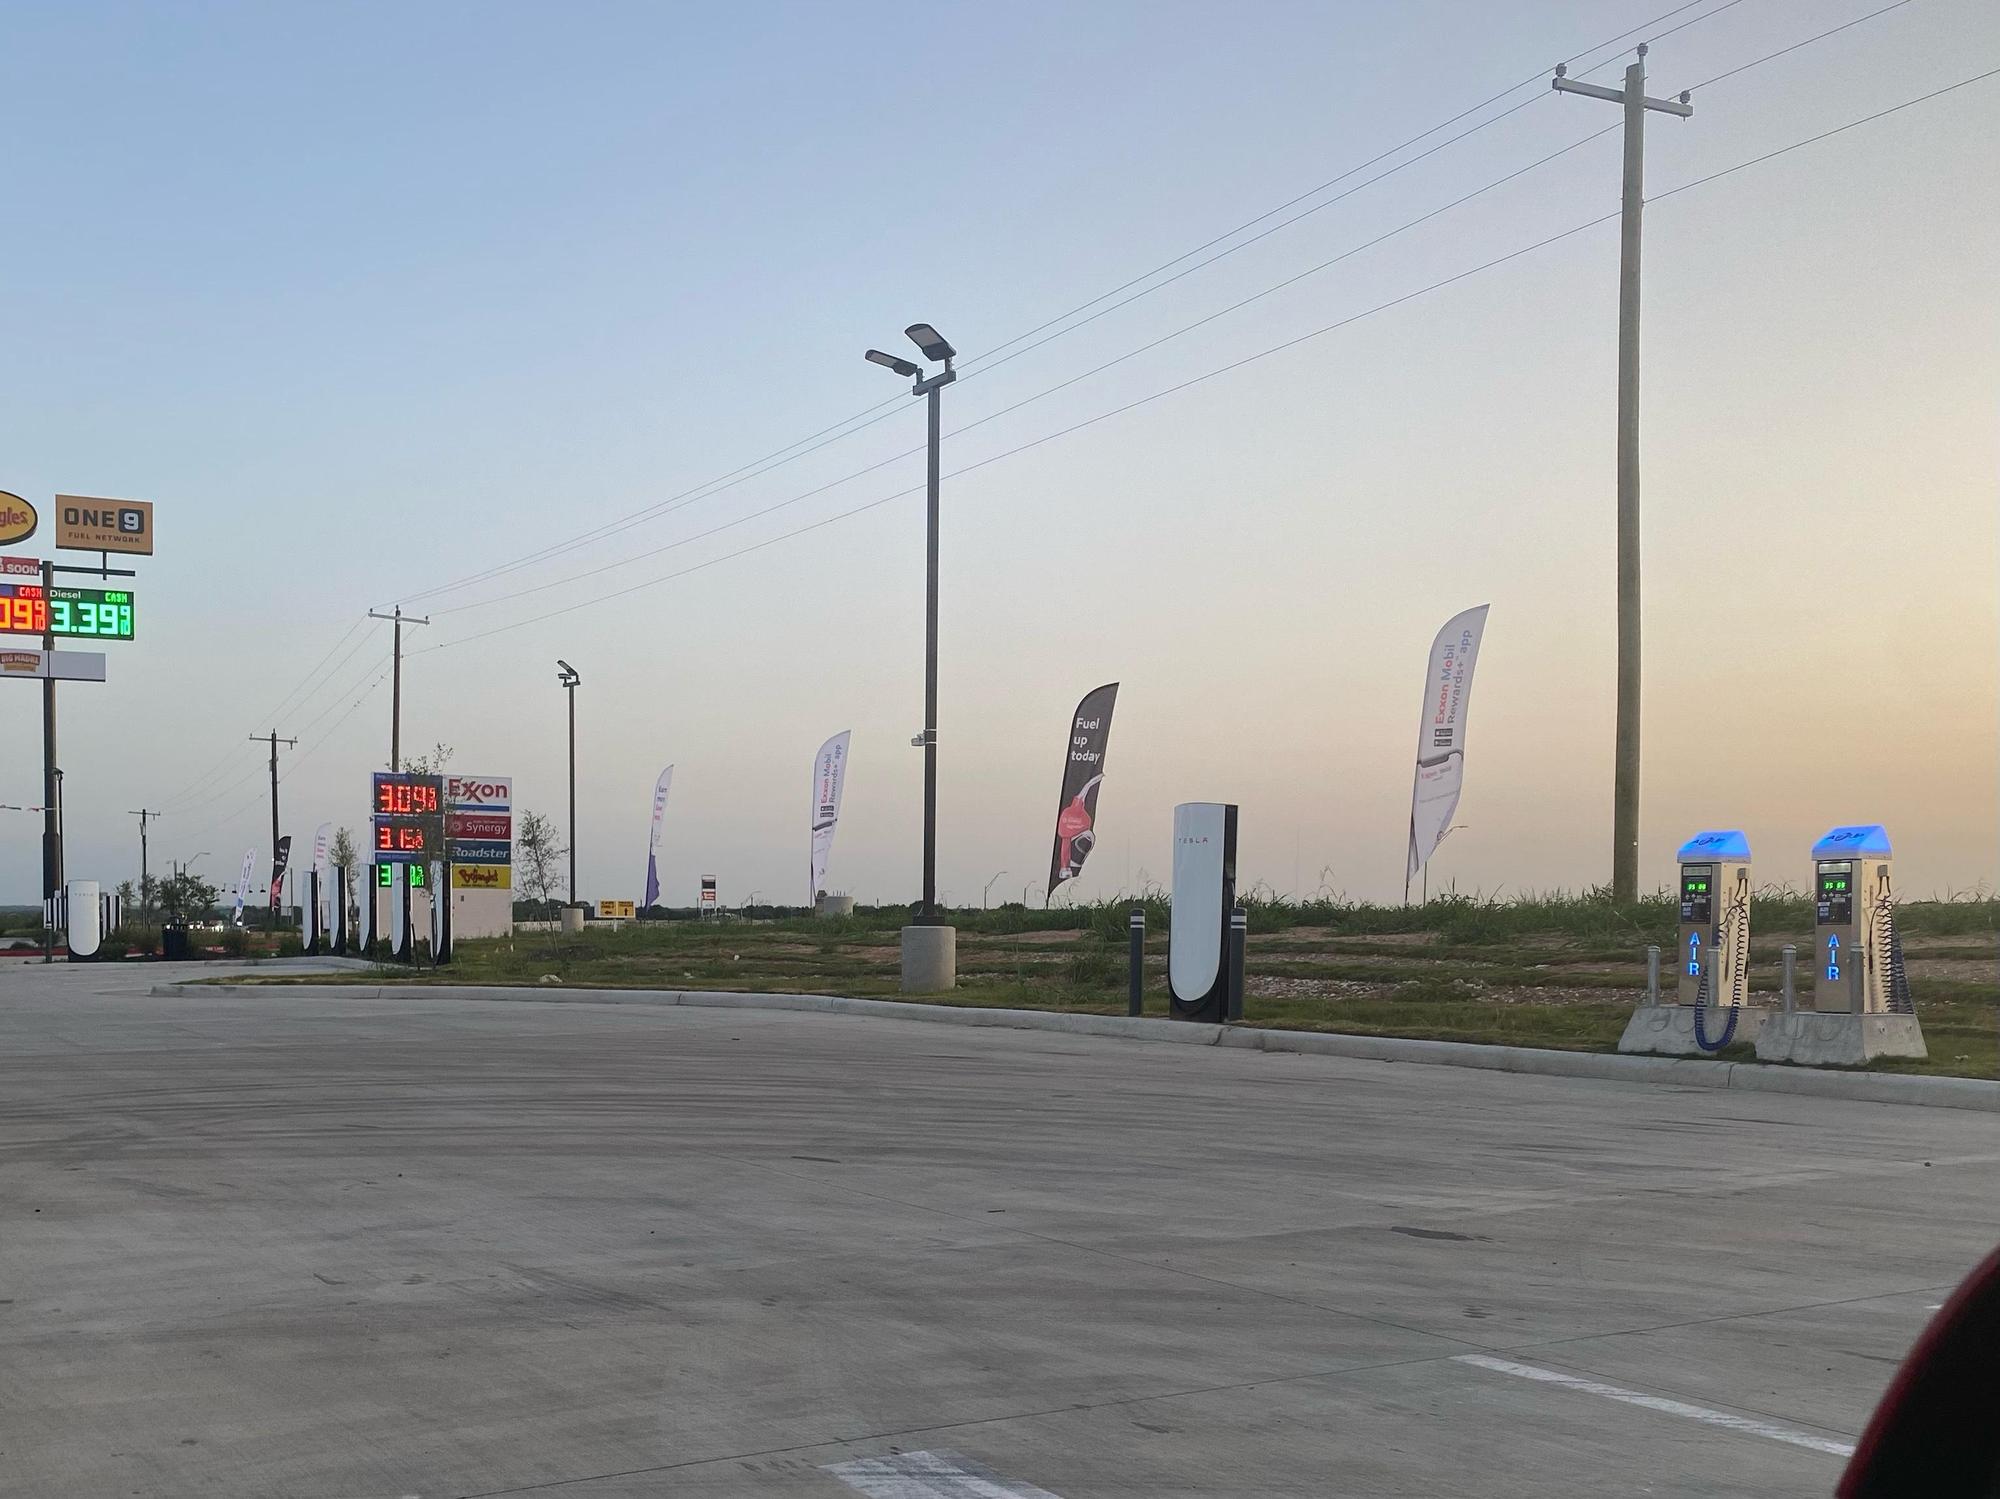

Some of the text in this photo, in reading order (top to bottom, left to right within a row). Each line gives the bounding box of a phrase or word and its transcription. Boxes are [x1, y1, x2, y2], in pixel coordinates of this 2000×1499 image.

[64, 507, 115, 528] ONE
[68, 531, 141, 544] FUEL NETWORK
[7, 563, 38, 574] SOON
[20, 586, 43, 598] CASH
[50, 589, 128, 604] Diesel CASH
[1460, 630, 1472, 653] app
[1440, 644, 1455, 680] Mobil
[1435, 684, 1449, 724] Exxon
[1075, 717, 1100, 729] Fuel
[1073, 736, 1088, 748] up
[1071, 750, 1100, 764] today
[448, 778, 508, 803] Exxon
[466, 821, 507, 835] Synergy
[452, 847, 509, 858] Roadster
